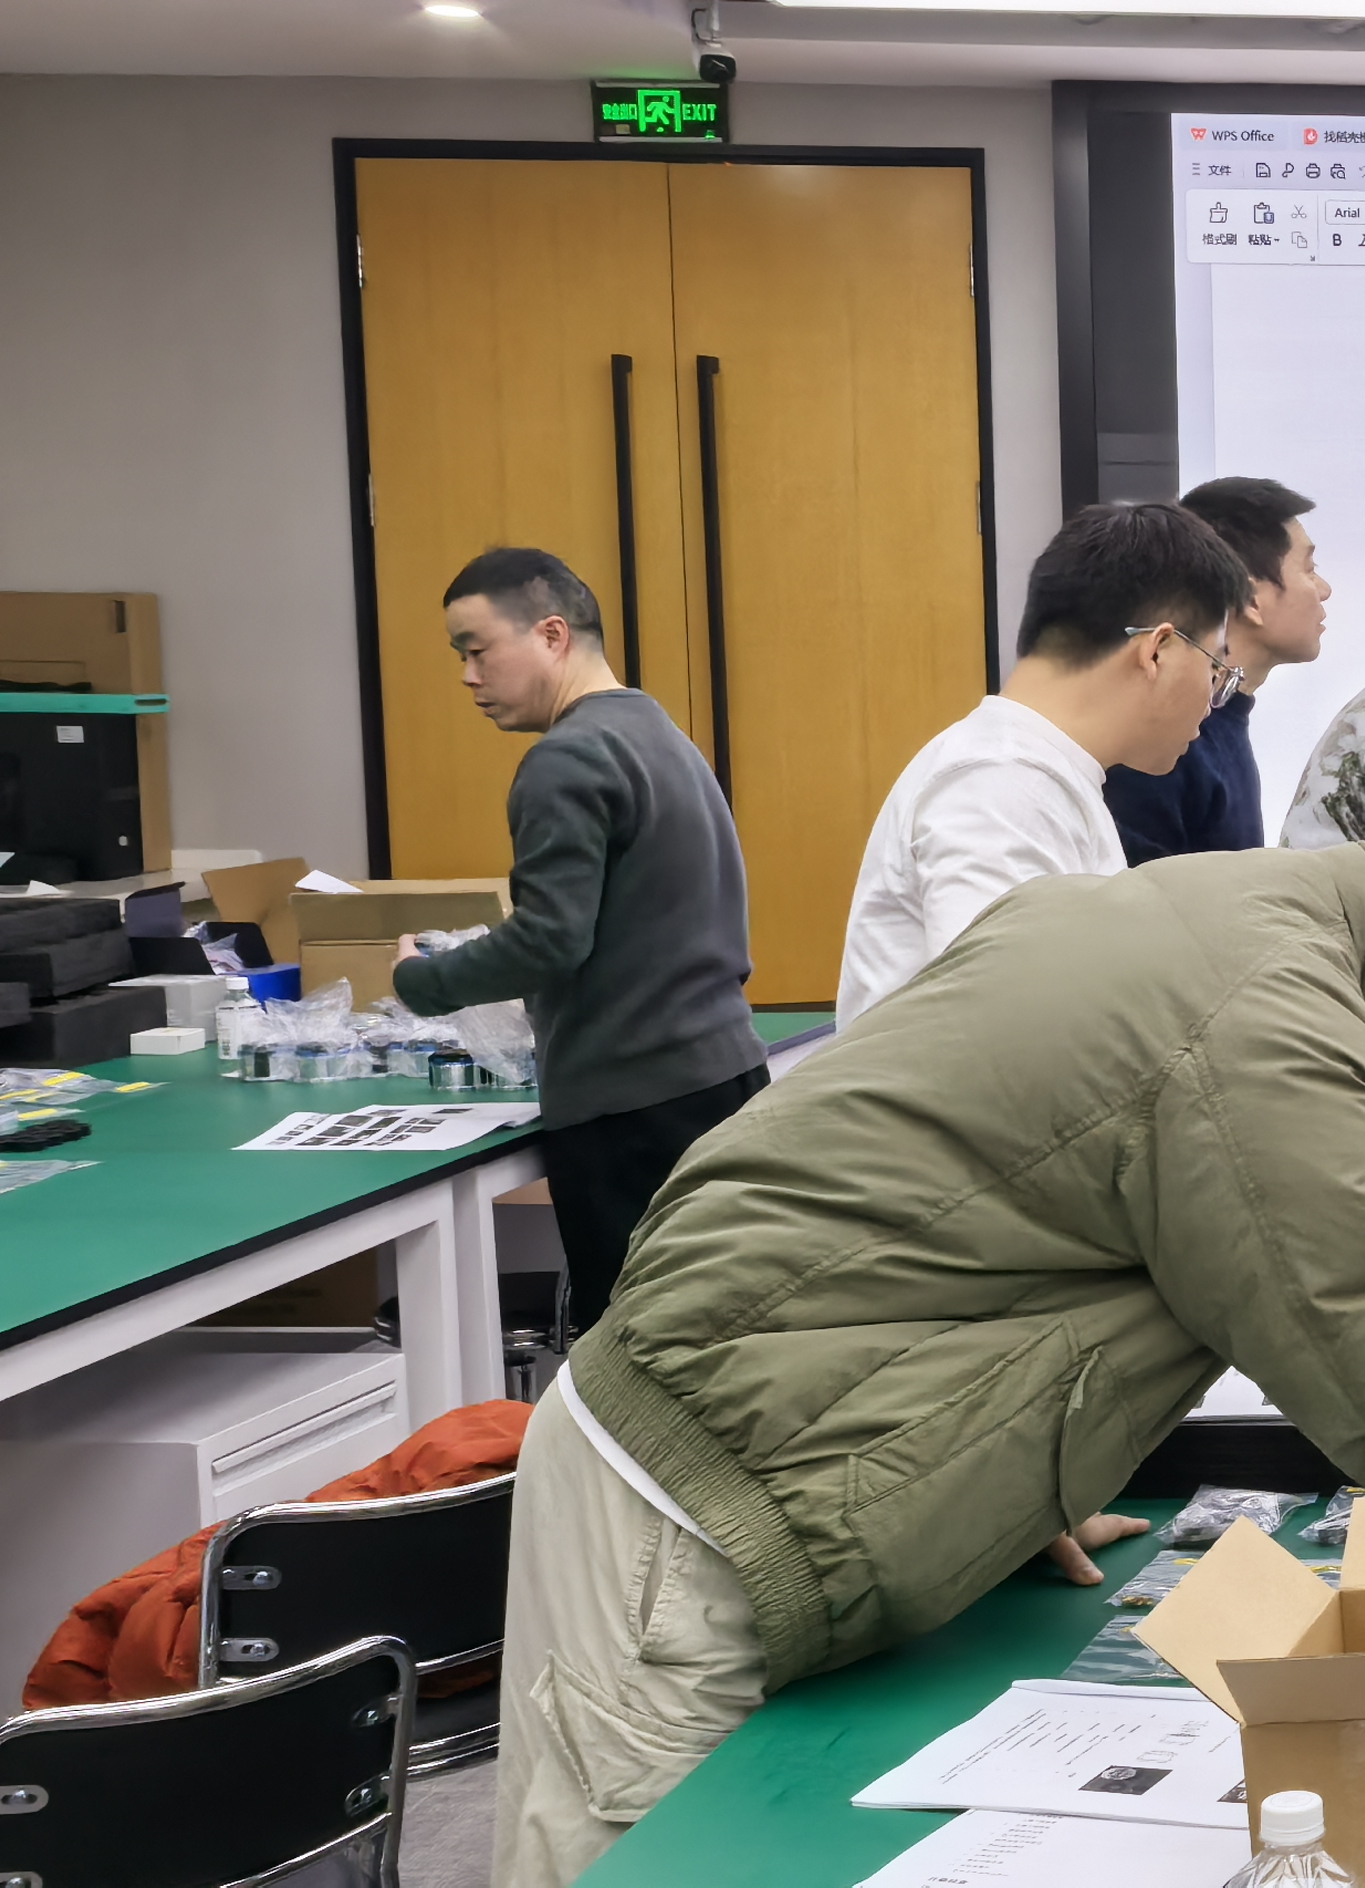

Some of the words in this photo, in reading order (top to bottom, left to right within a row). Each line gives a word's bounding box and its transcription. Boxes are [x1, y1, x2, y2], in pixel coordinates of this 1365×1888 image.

[682, 103, 717, 121] EXIT
[1212, 130, 1238, 142] WPS
[1241, 129, 1275, 142] Office
[1208, 165, 1232, 177] 文件
[1334, 207, 1361, 219] Arial
[1248, 233, 1272, 246] 粘贴
